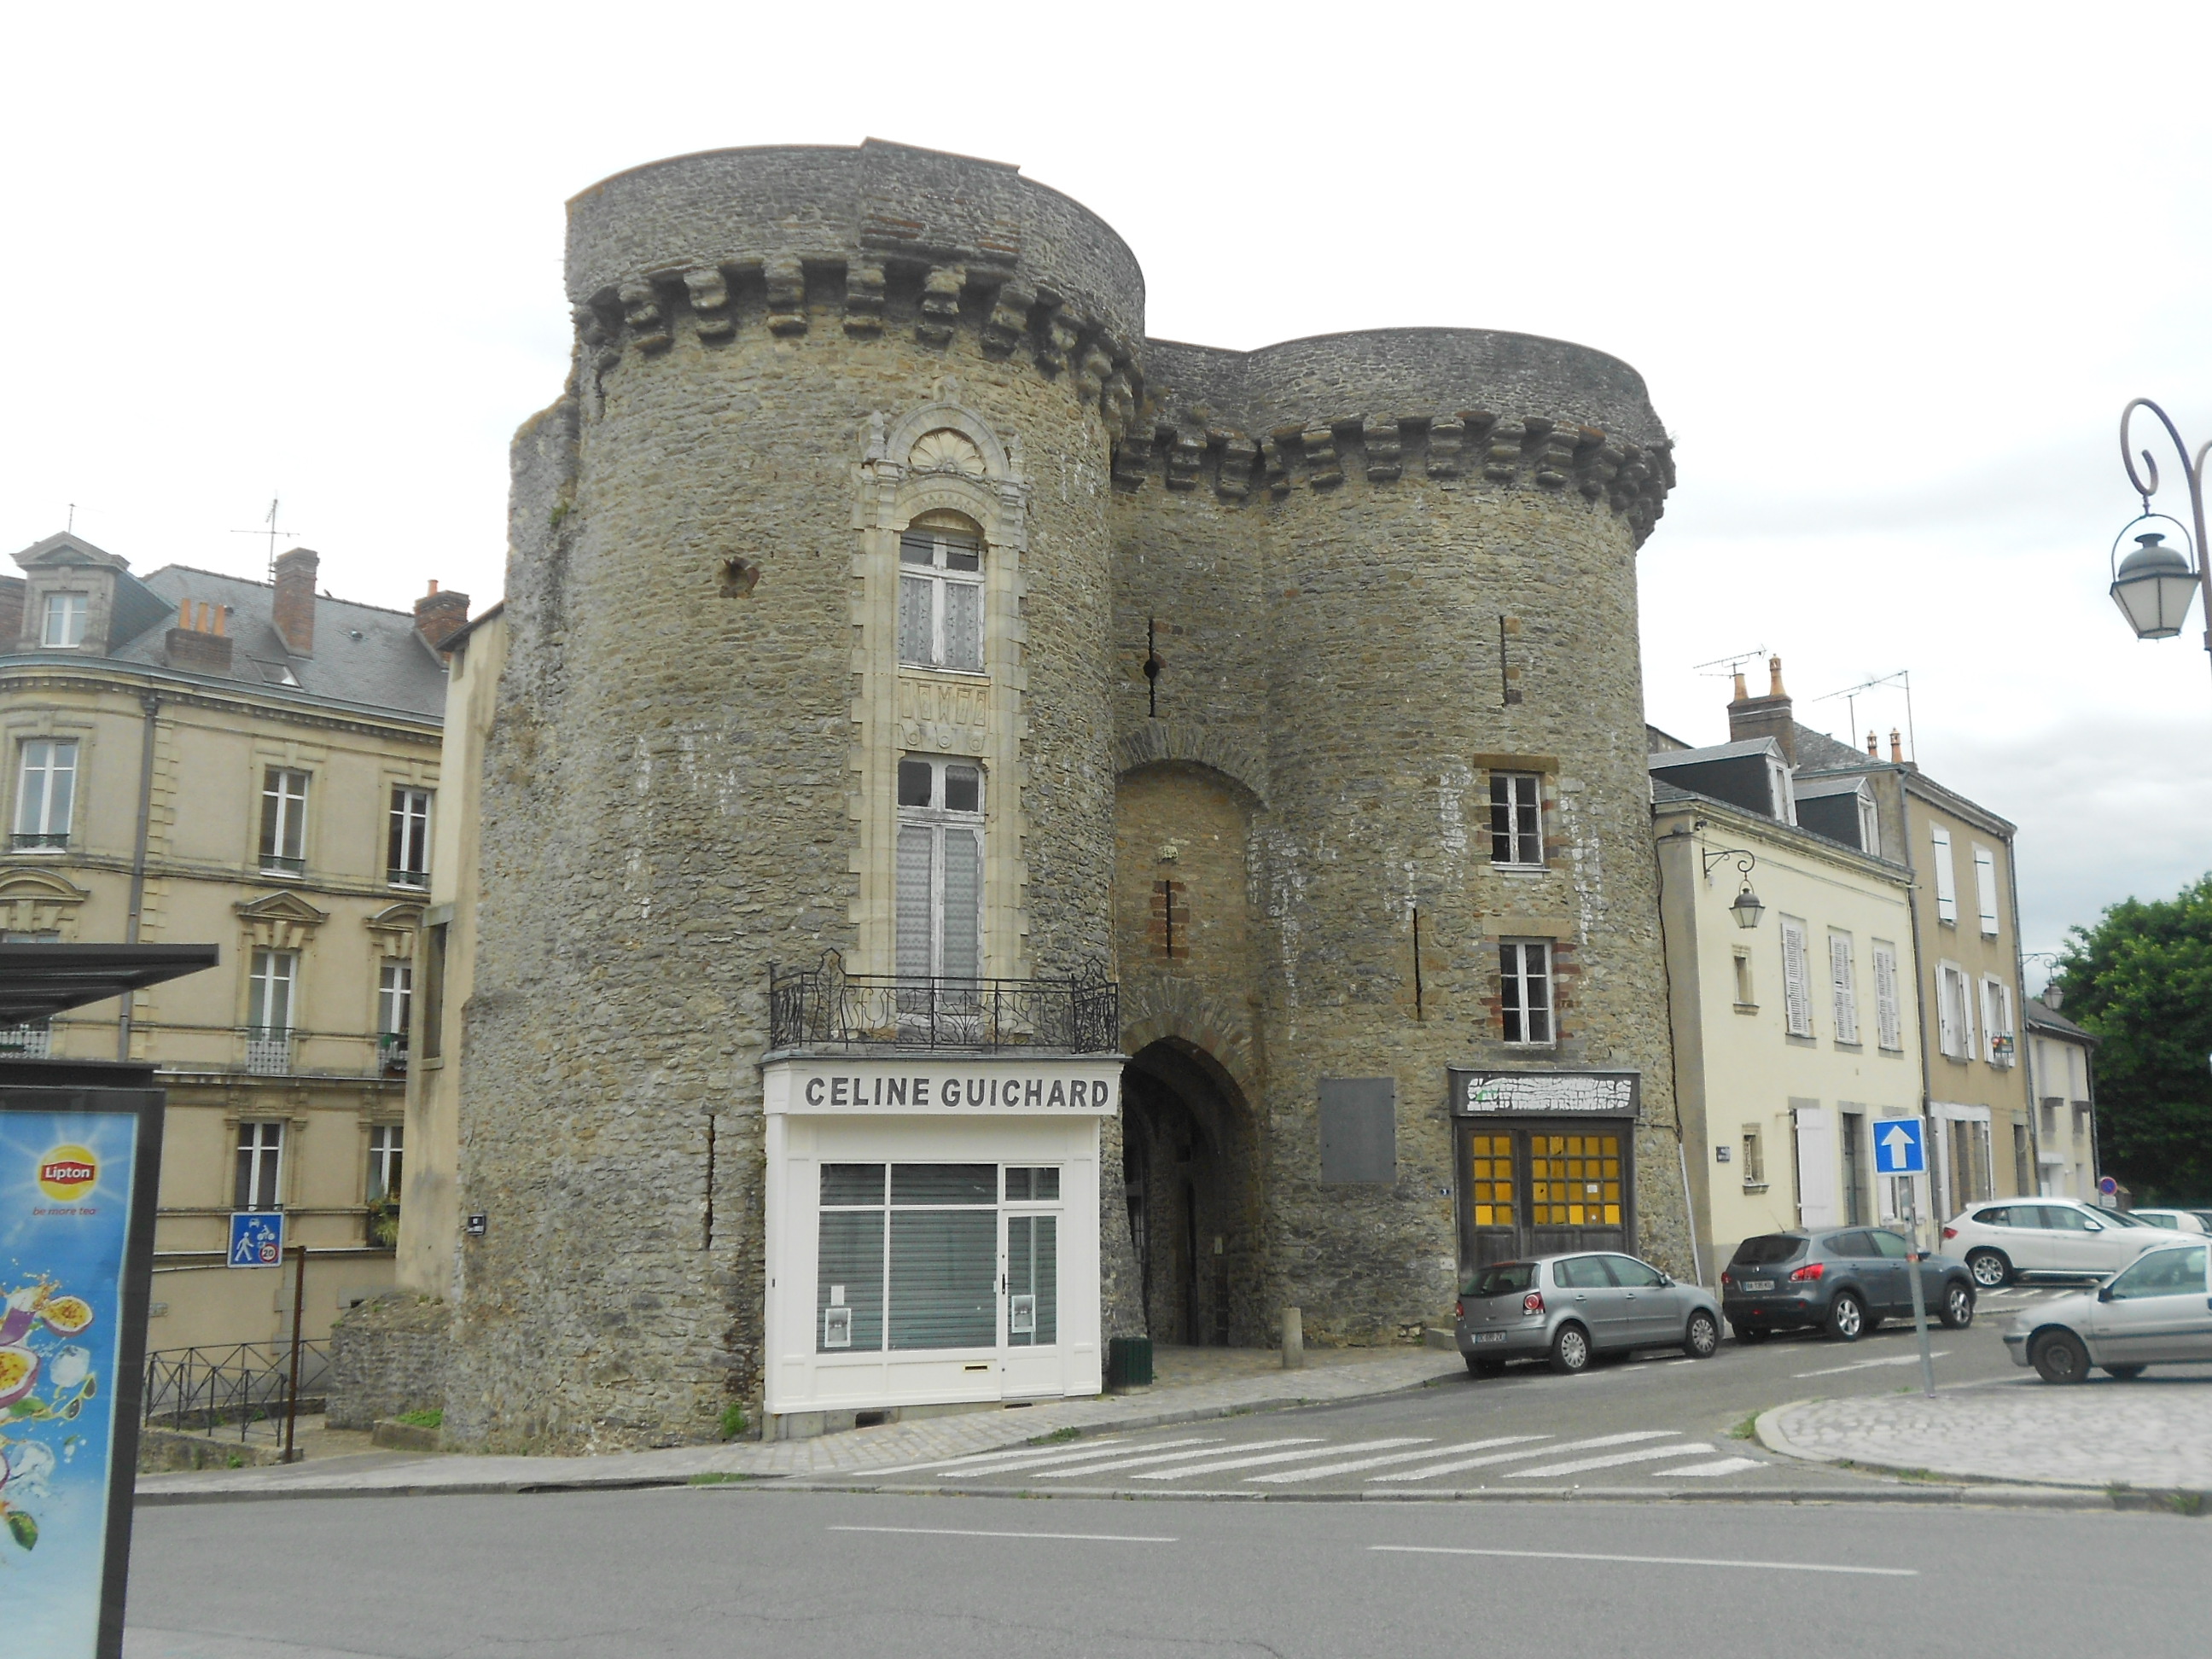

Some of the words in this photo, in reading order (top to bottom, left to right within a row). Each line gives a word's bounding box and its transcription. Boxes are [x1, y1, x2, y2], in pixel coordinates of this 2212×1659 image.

[805, 1077, 930, 1107] CELINE
[940, 1078, 1109, 1108] GUICHARD
[45, 1166, 90, 1180] Lipton
[32, 1206, 45, 1216] be
[48, 1208, 76, 1216] more
[263, 1249, 274, 1257] 20
